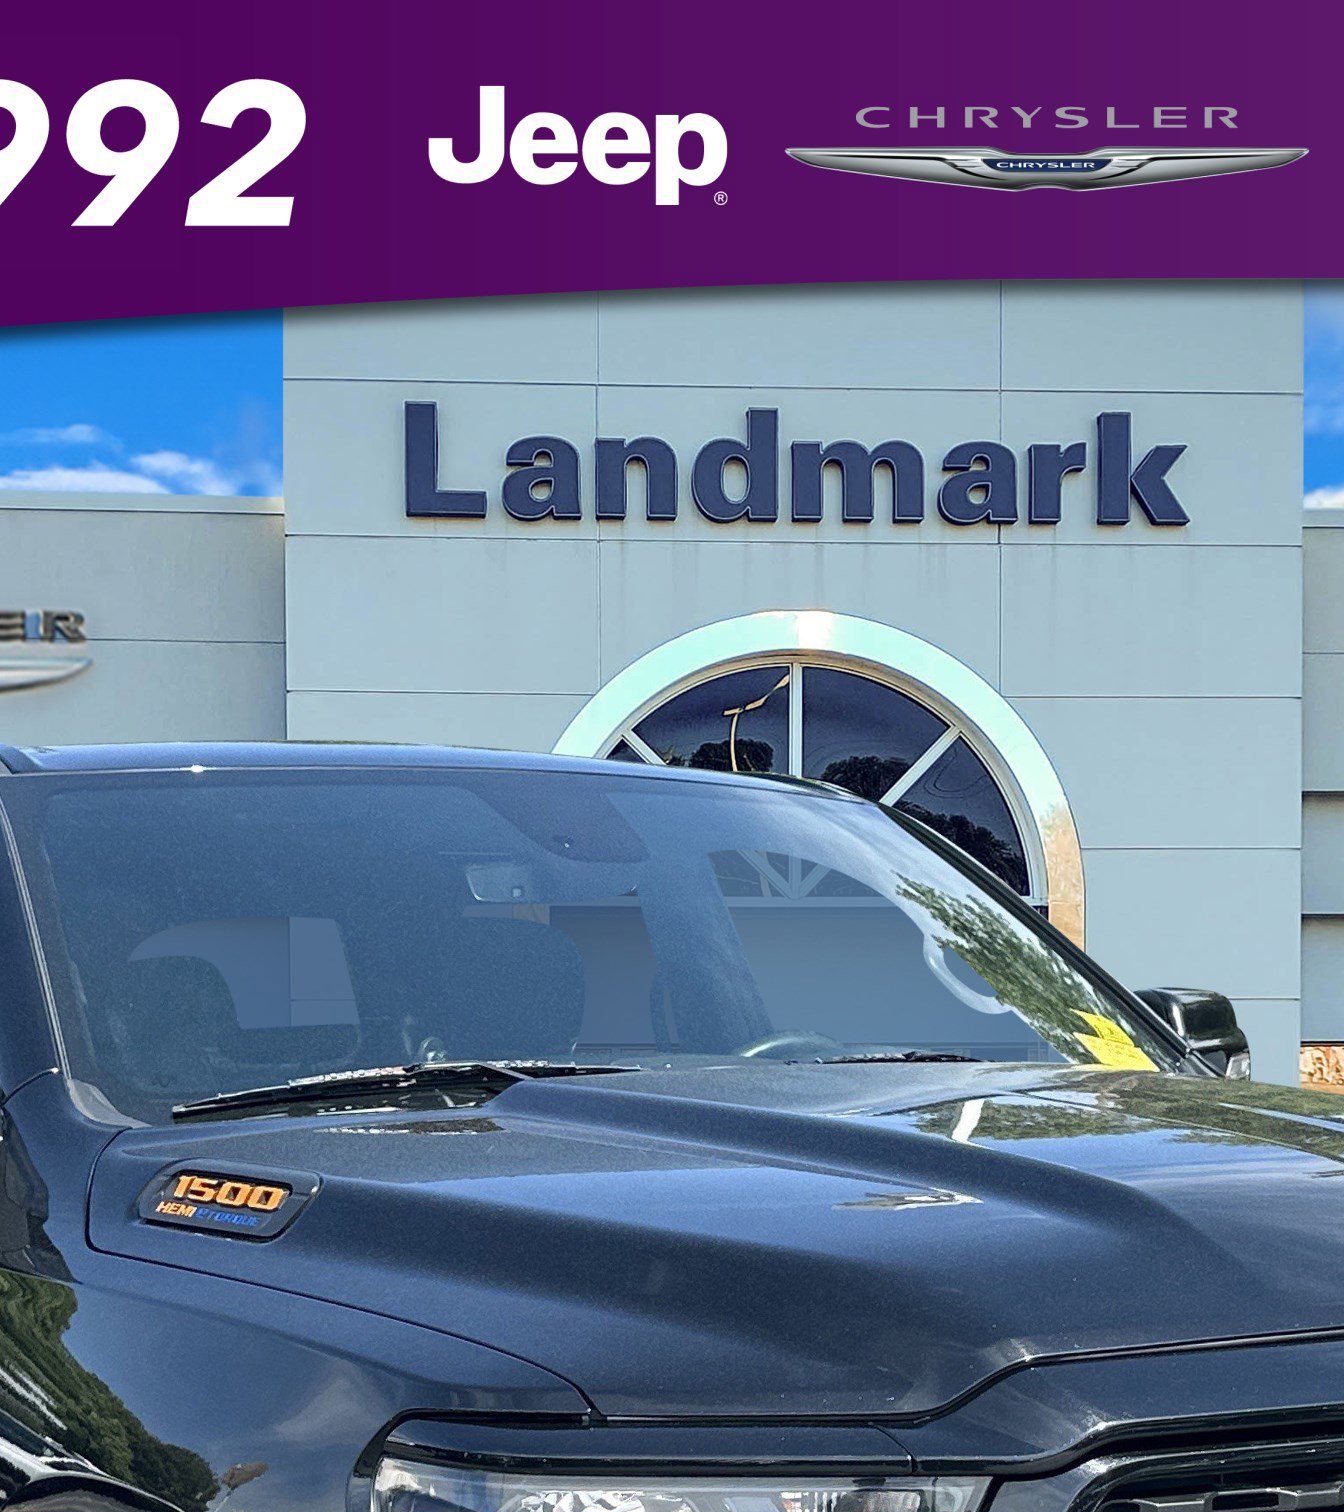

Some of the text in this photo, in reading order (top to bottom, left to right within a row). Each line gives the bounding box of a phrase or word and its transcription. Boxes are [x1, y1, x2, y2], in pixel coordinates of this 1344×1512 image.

[404, 400, 1192, 528] Landmark
[156, 1201, 198, 1218] HEMI
[173, 1174, 290, 1211] 1500
